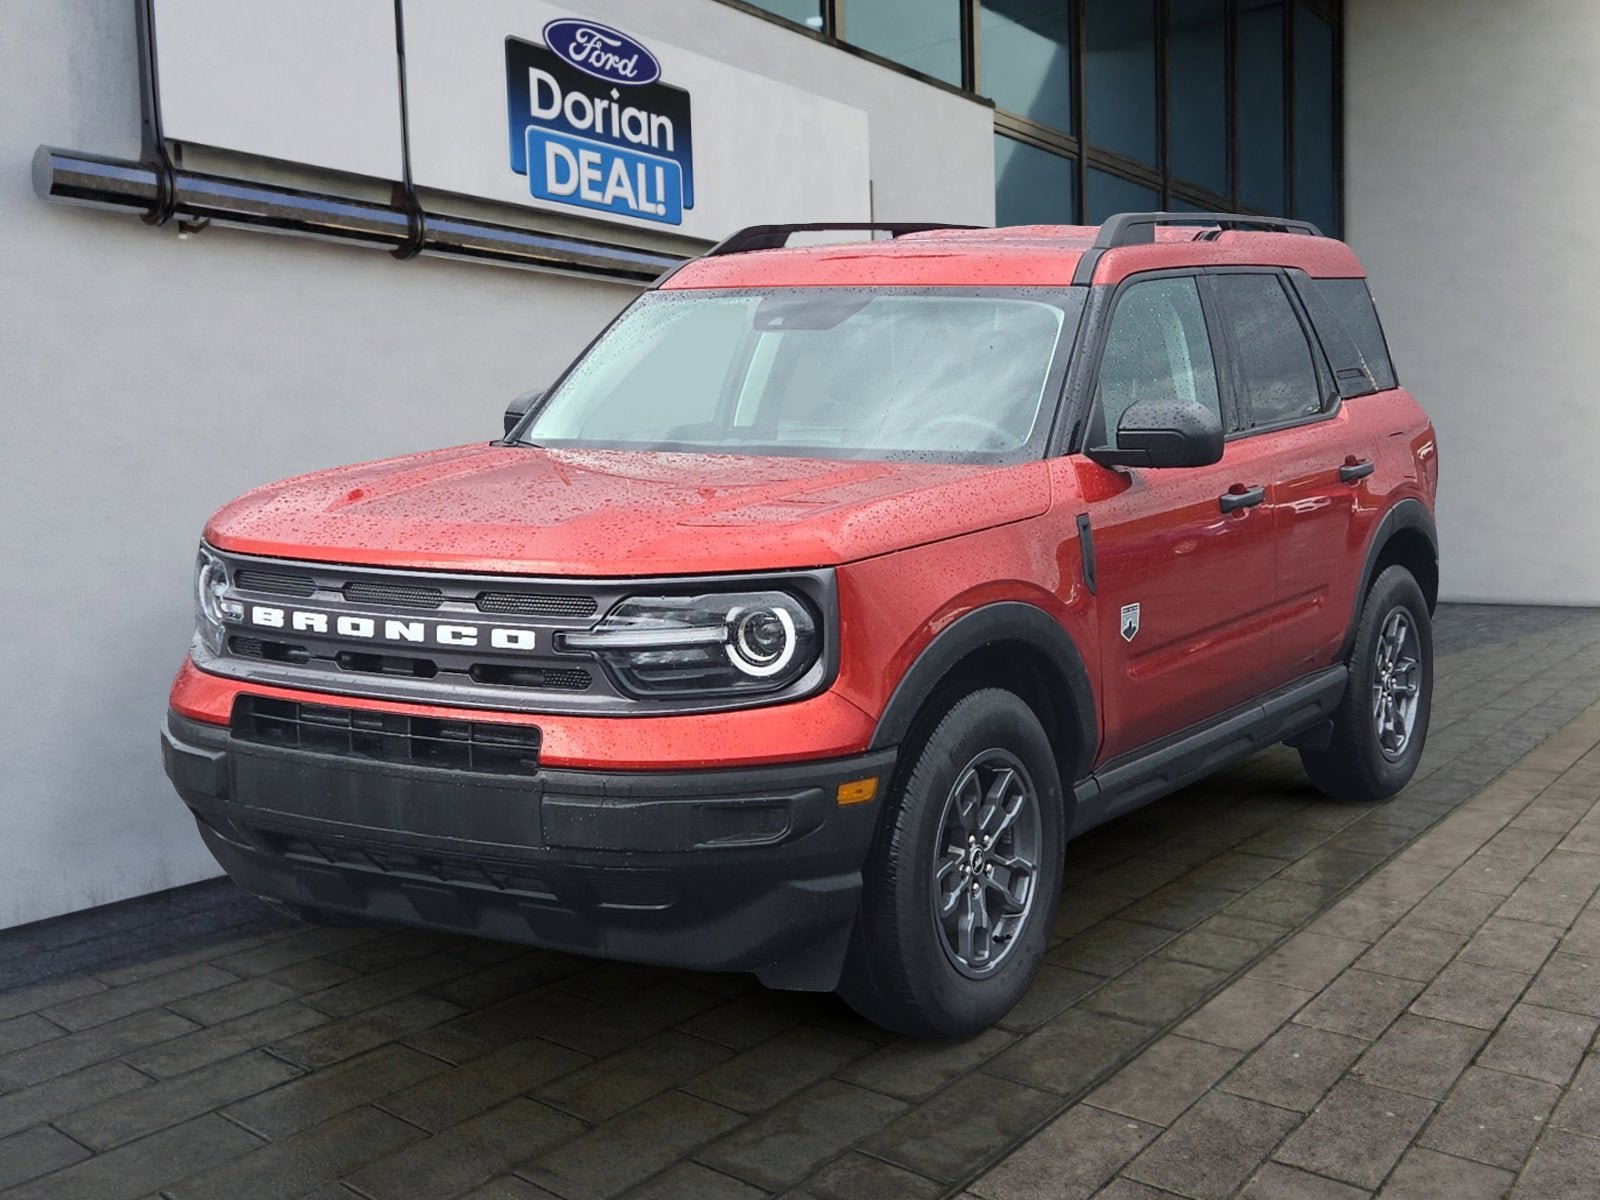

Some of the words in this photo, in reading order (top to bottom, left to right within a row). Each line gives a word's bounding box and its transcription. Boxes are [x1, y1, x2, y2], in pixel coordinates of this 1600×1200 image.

[568, 27, 639, 78] Ford
[528, 66, 674, 151] Dorian
[545, 140, 666, 217] DEAL!
[251, 606, 536, 651] BRONCO
